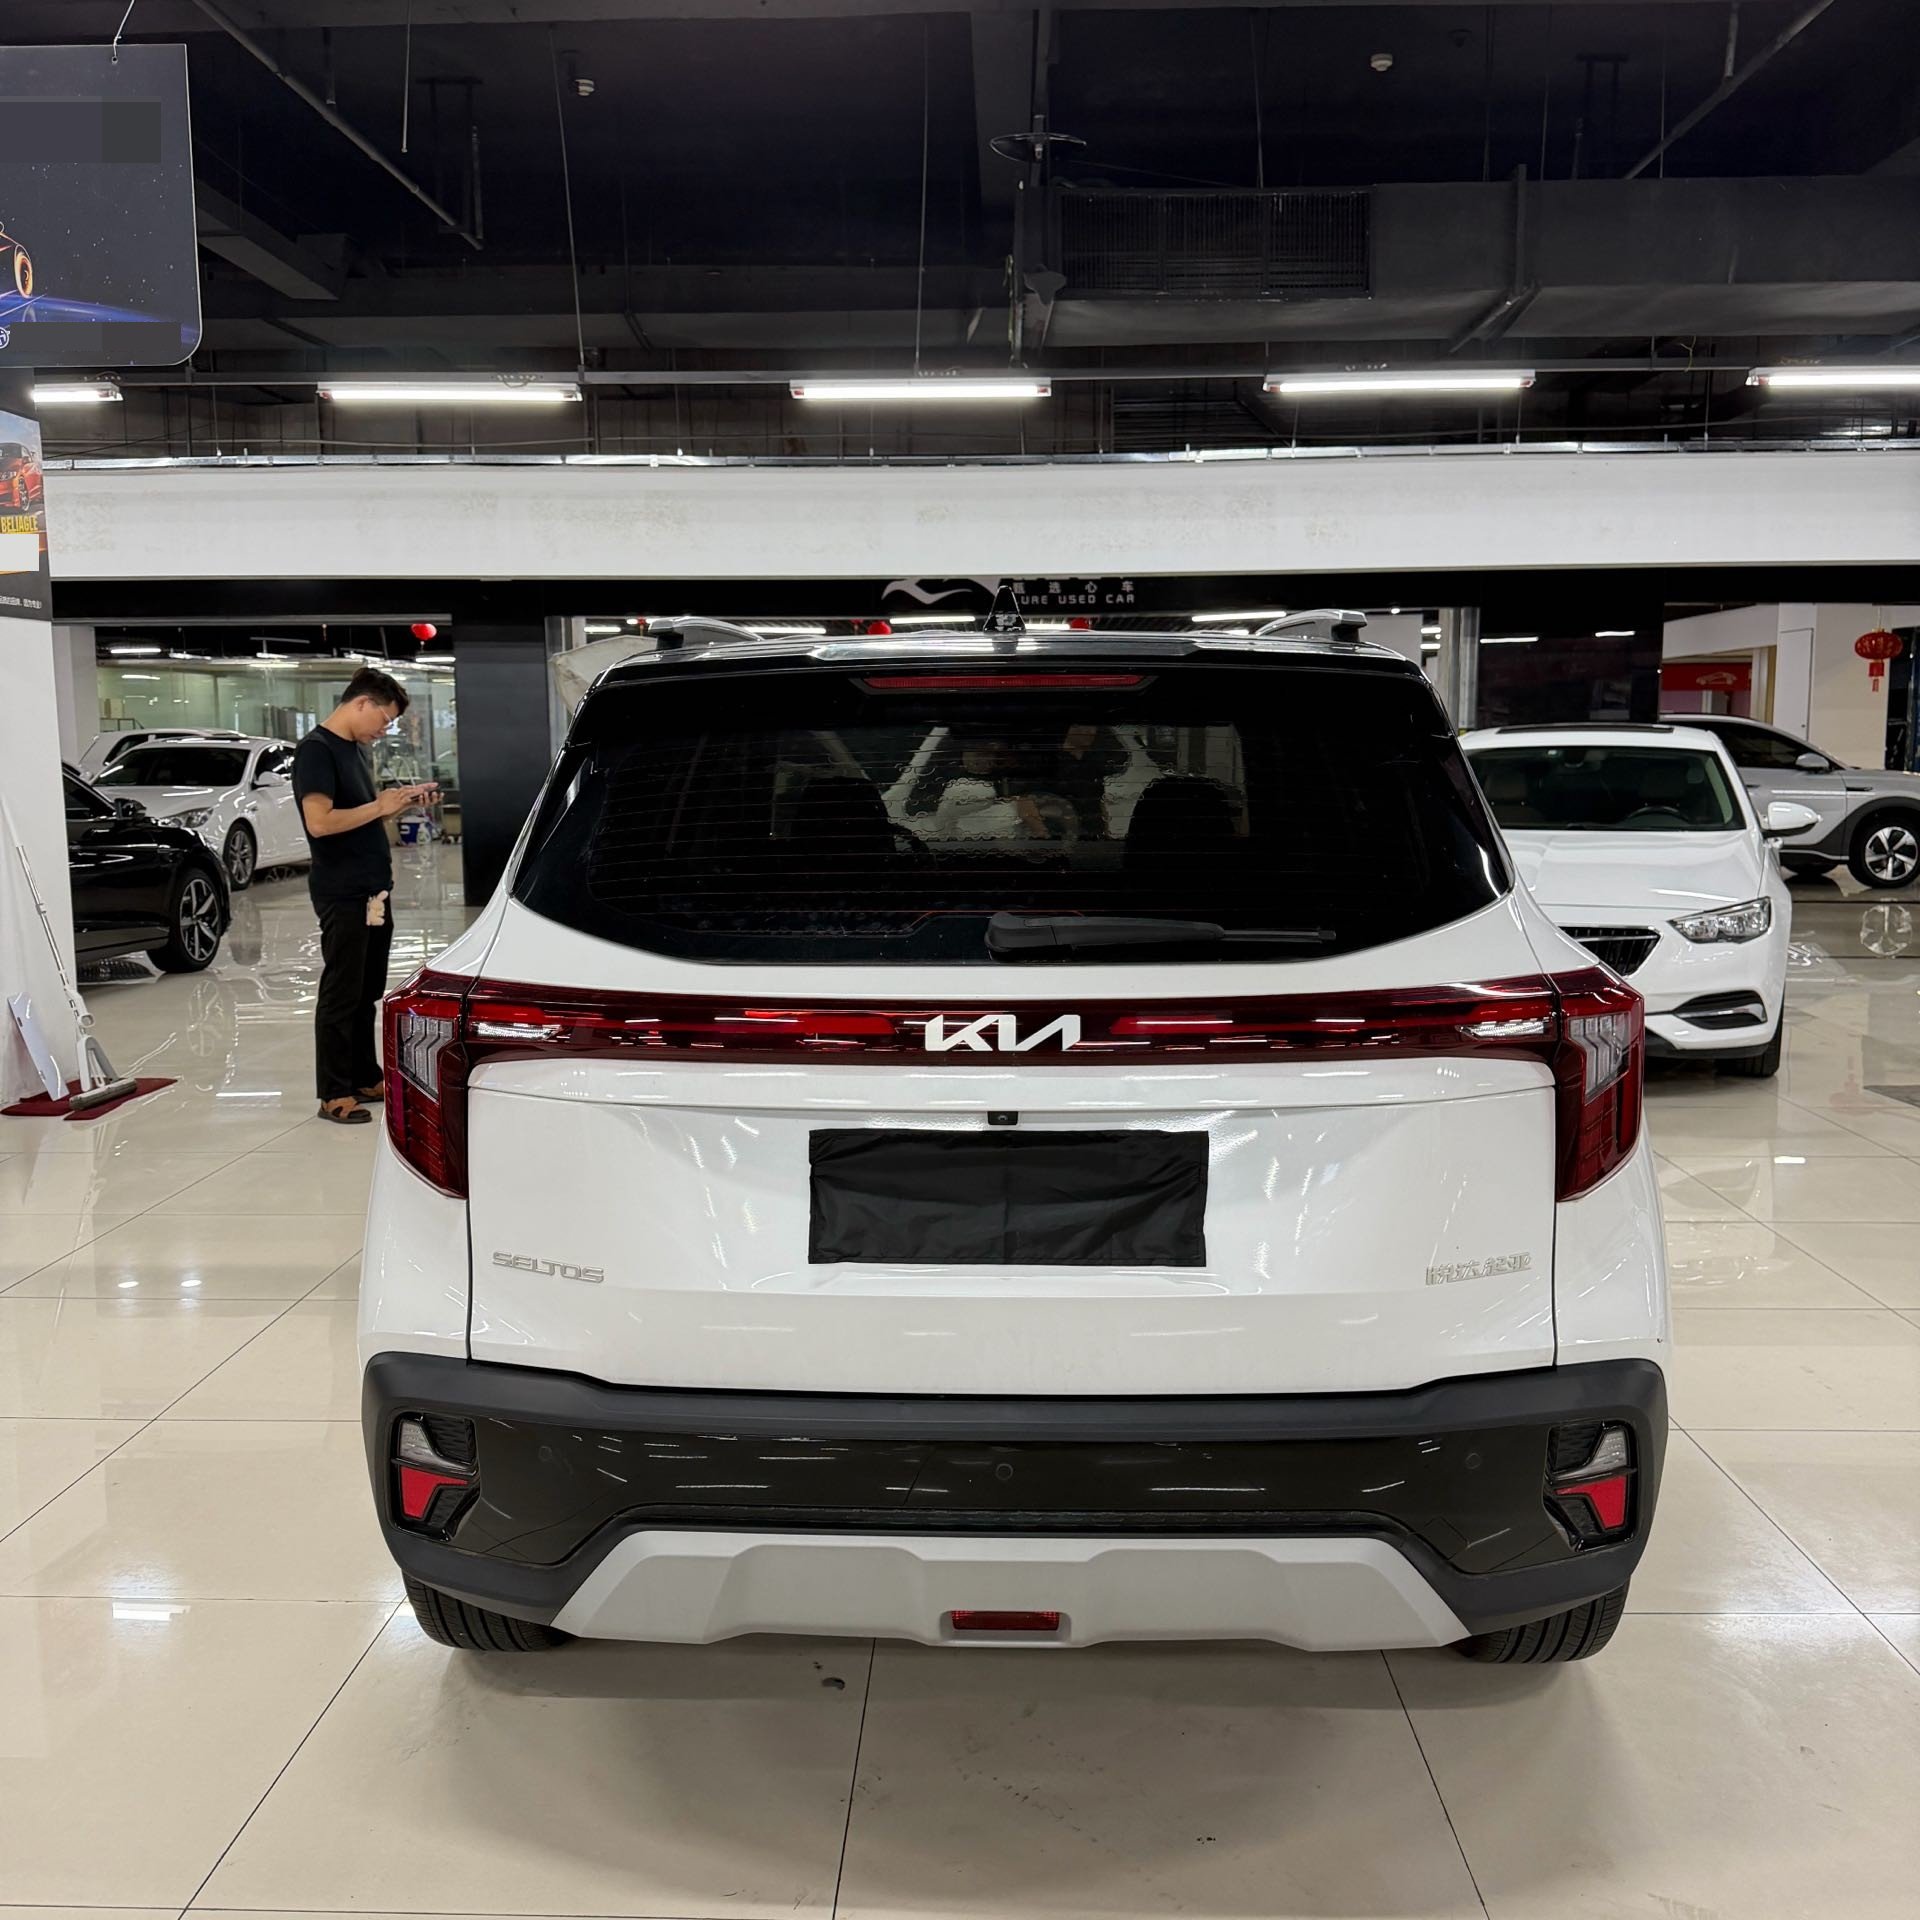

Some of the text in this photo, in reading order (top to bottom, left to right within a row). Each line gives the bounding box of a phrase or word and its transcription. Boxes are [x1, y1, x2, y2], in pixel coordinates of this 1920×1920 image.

[1018, 594, 1135, 605] URE USED CAR
[925, 1014, 1081, 1051] KIA
[493, 1252, 604, 1283] SELTOS
